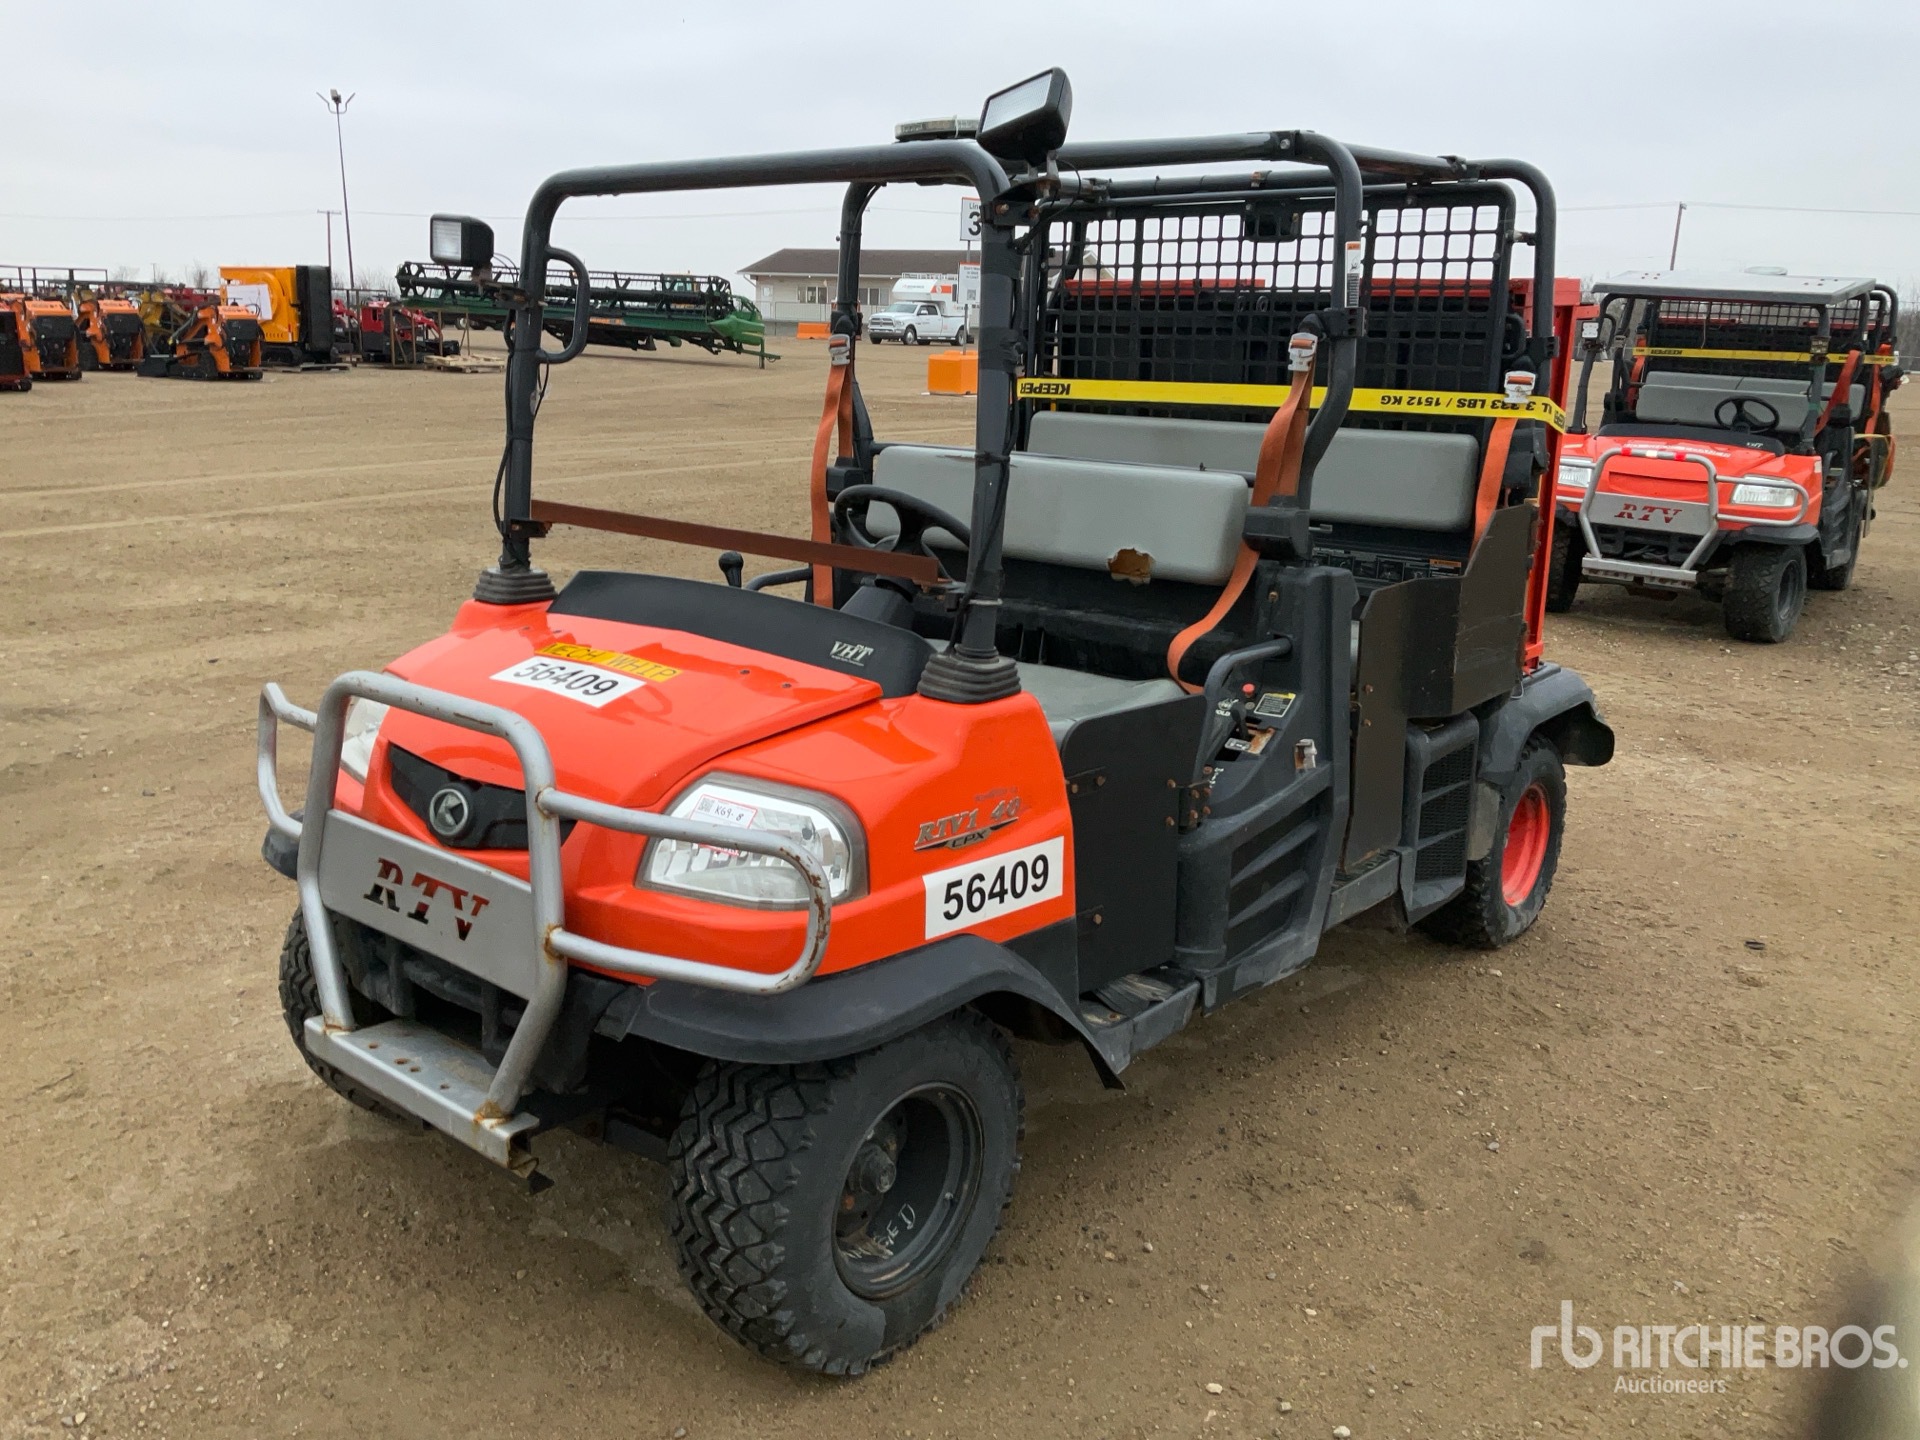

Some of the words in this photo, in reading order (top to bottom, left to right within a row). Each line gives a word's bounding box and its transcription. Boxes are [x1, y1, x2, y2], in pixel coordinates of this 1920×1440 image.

[1020, 382, 1071, 396] KEEPER
[1380, 395, 1403, 406] KG
[1407, 396, 1441, 407] 1512
[1456, 398, 1487, 409] LBS
[1614, 502, 1682, 524] RTV
[606, 653, 678, 681] WHIP
[513, 662, 619, 696] 56409
[943, 853, 1049, 921] 56409
[363, 857, 490, 942] RTV
